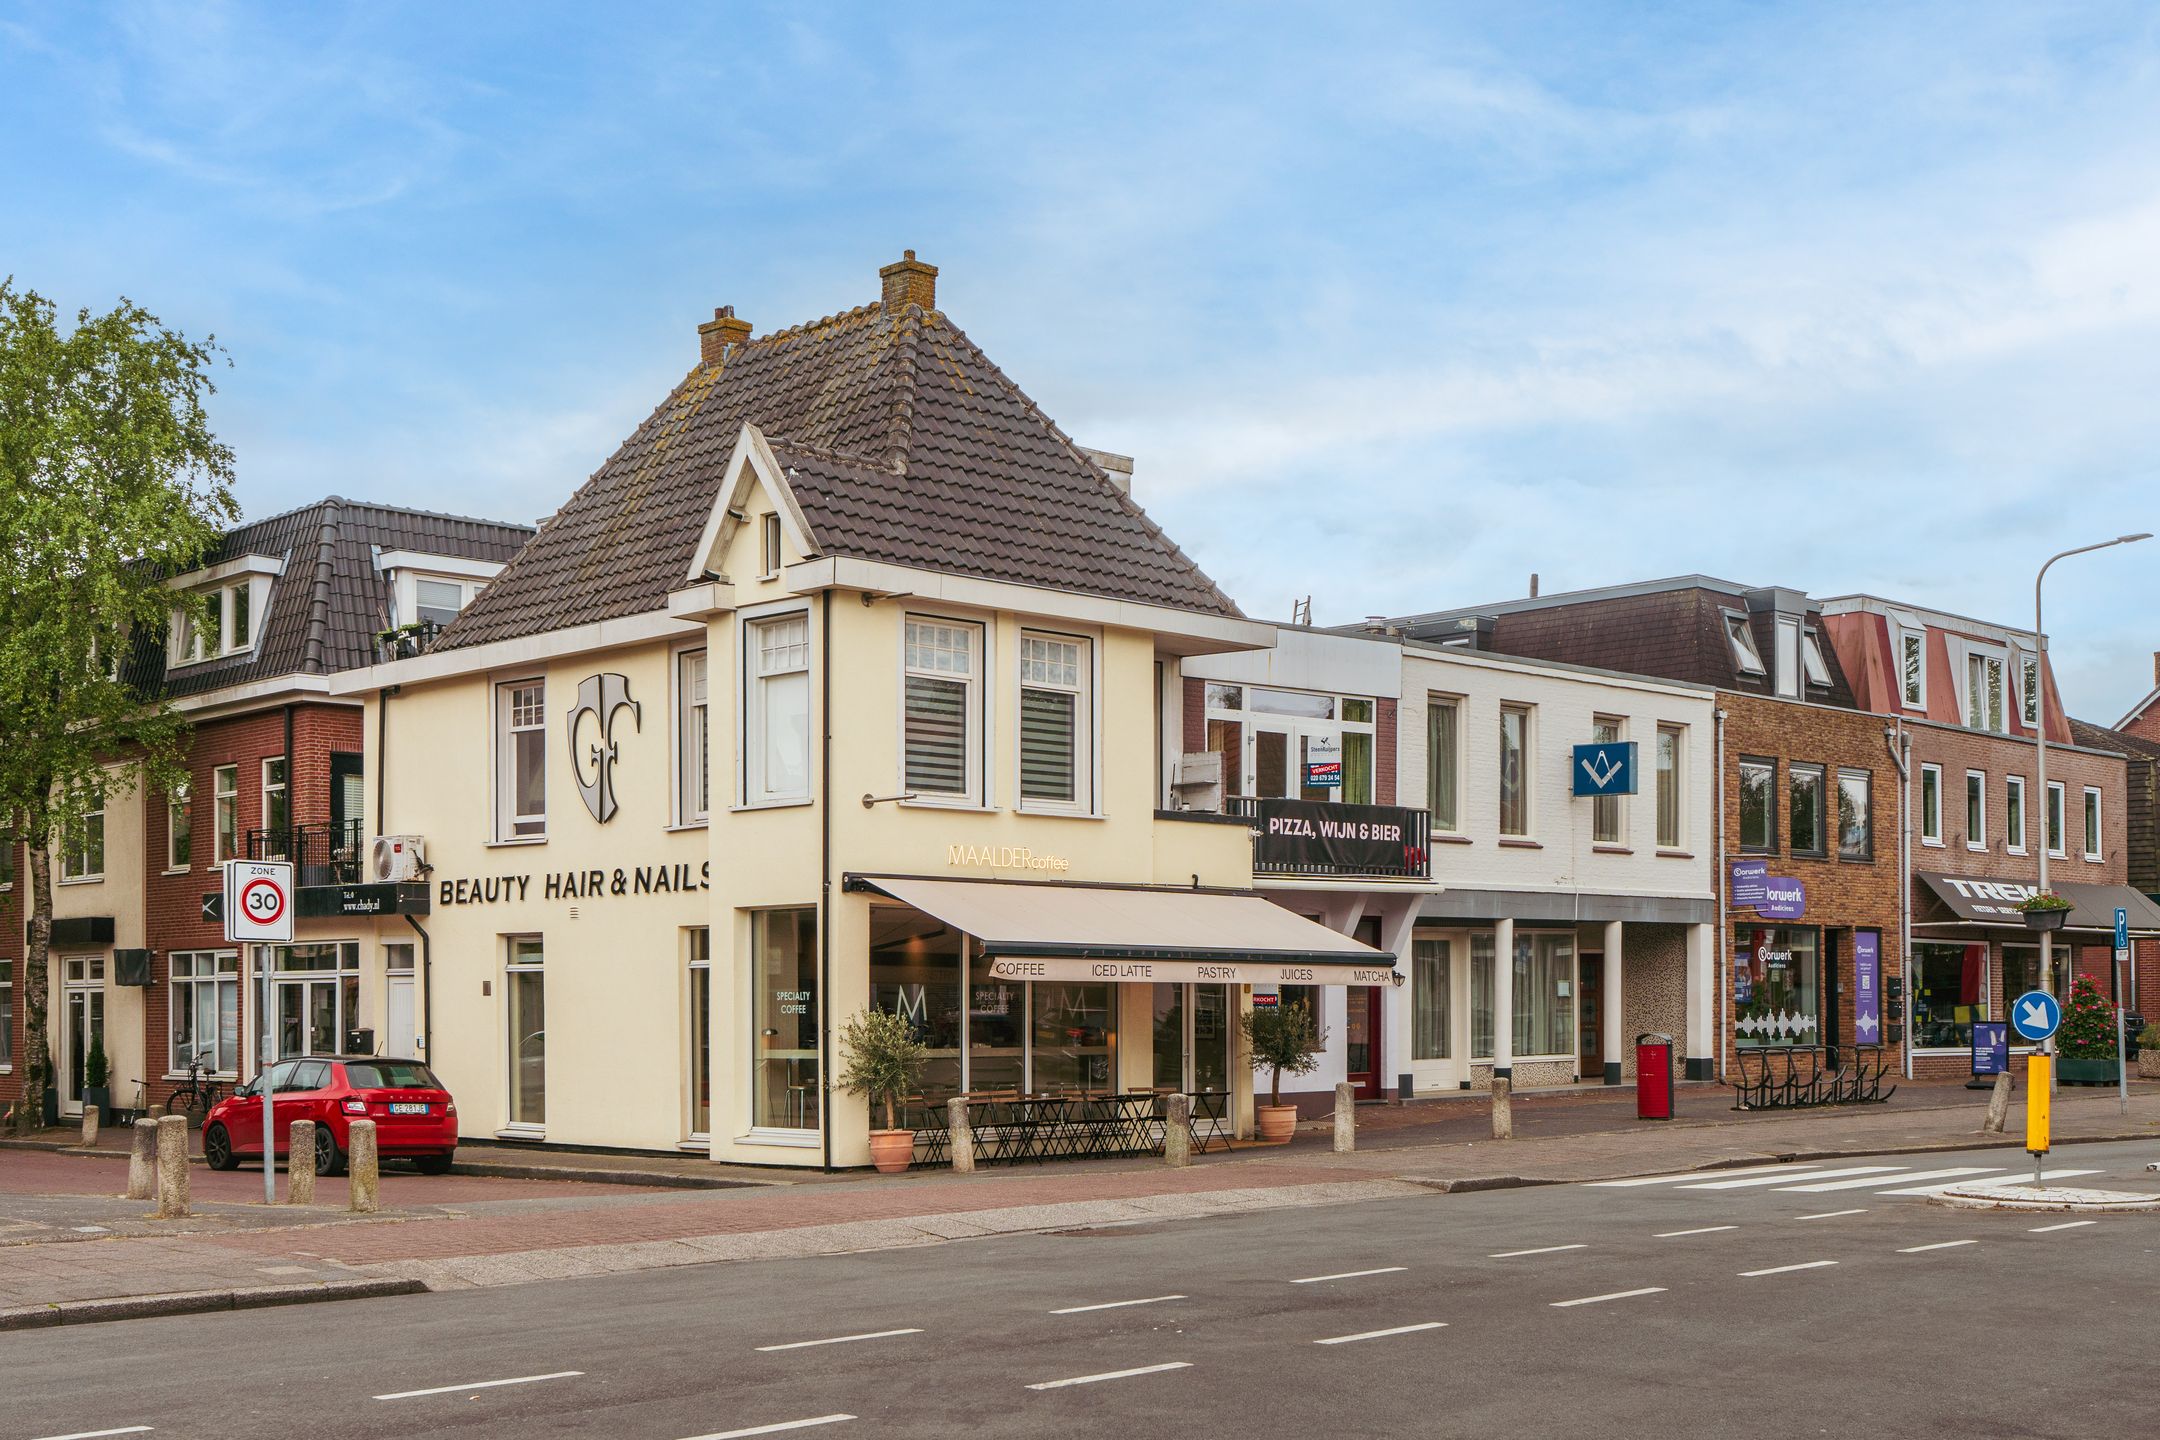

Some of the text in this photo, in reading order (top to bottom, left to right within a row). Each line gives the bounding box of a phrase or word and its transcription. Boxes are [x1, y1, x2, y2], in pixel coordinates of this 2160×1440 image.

[1269, 817, 1401, 842] PIZZA, WIJN & BIER
[250, 866, 276, 876] ZONE
[440, 875, 530, 905] BEAUTY
[1766, 886, 1802, 902] orwerk
[1942, 878, 2039, 902] TREK
[249, 892, 278, 911] 30
[2118, 911, 2126, 933] P
[995, 962, 1391, 983] COFFEE ICED LATTE PASTRY JUICES MATCHA
[776, 991, 811, 1001] SPECIALTY
[896, 984, 928, 1021] M
[975, 991, 1015, 1001] SPECIALTY
[780, 1004, 807, 1014] COFFEE
[980, 1004, 1010, 1014] COFFEE
